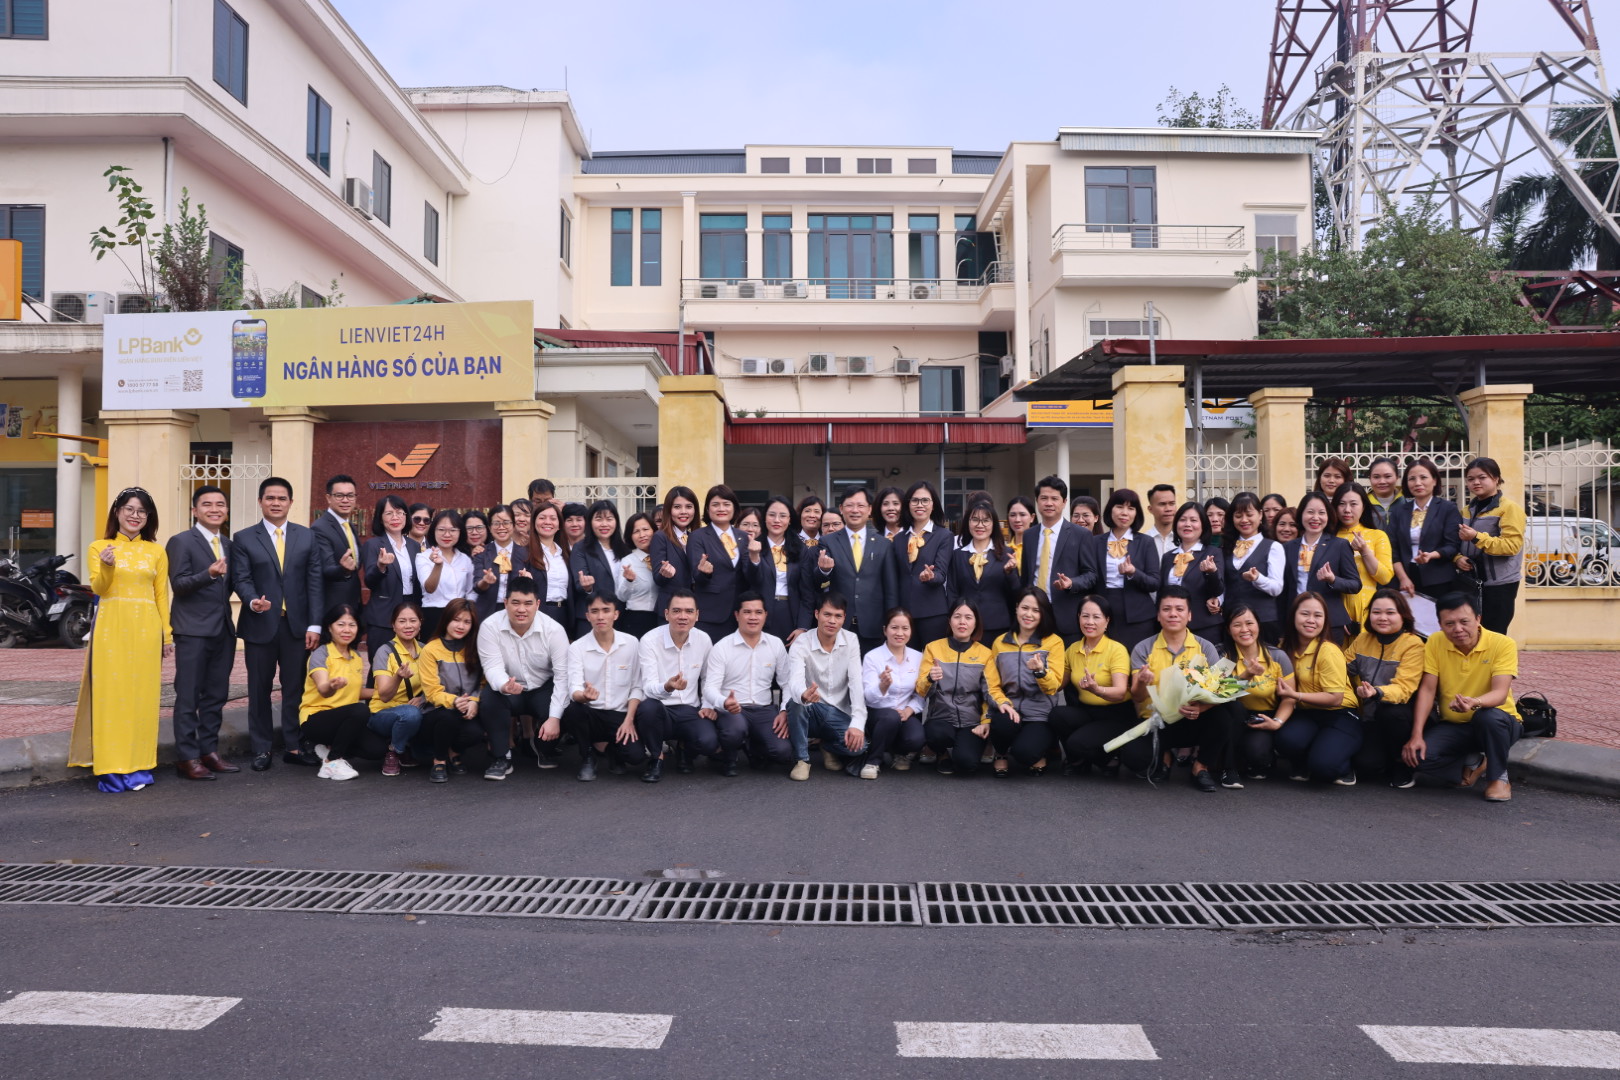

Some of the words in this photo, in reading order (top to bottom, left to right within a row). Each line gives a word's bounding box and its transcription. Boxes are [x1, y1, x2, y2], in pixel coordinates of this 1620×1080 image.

[340, 325, 445, 344] LIENVIET24H
[118, 336, 183, 355] LPBank
[283, 356, 333, 380] NGÂN
[337, 354, 388, 379] HÀNG
[392, 352, 417, 377] SỐ
[421, 351, 460, 376] CỦA
[464, 355, 502, 380] BẠN
[368, 481, 417, 490] VIETNAM
[418, 481, 450, 490] POST
